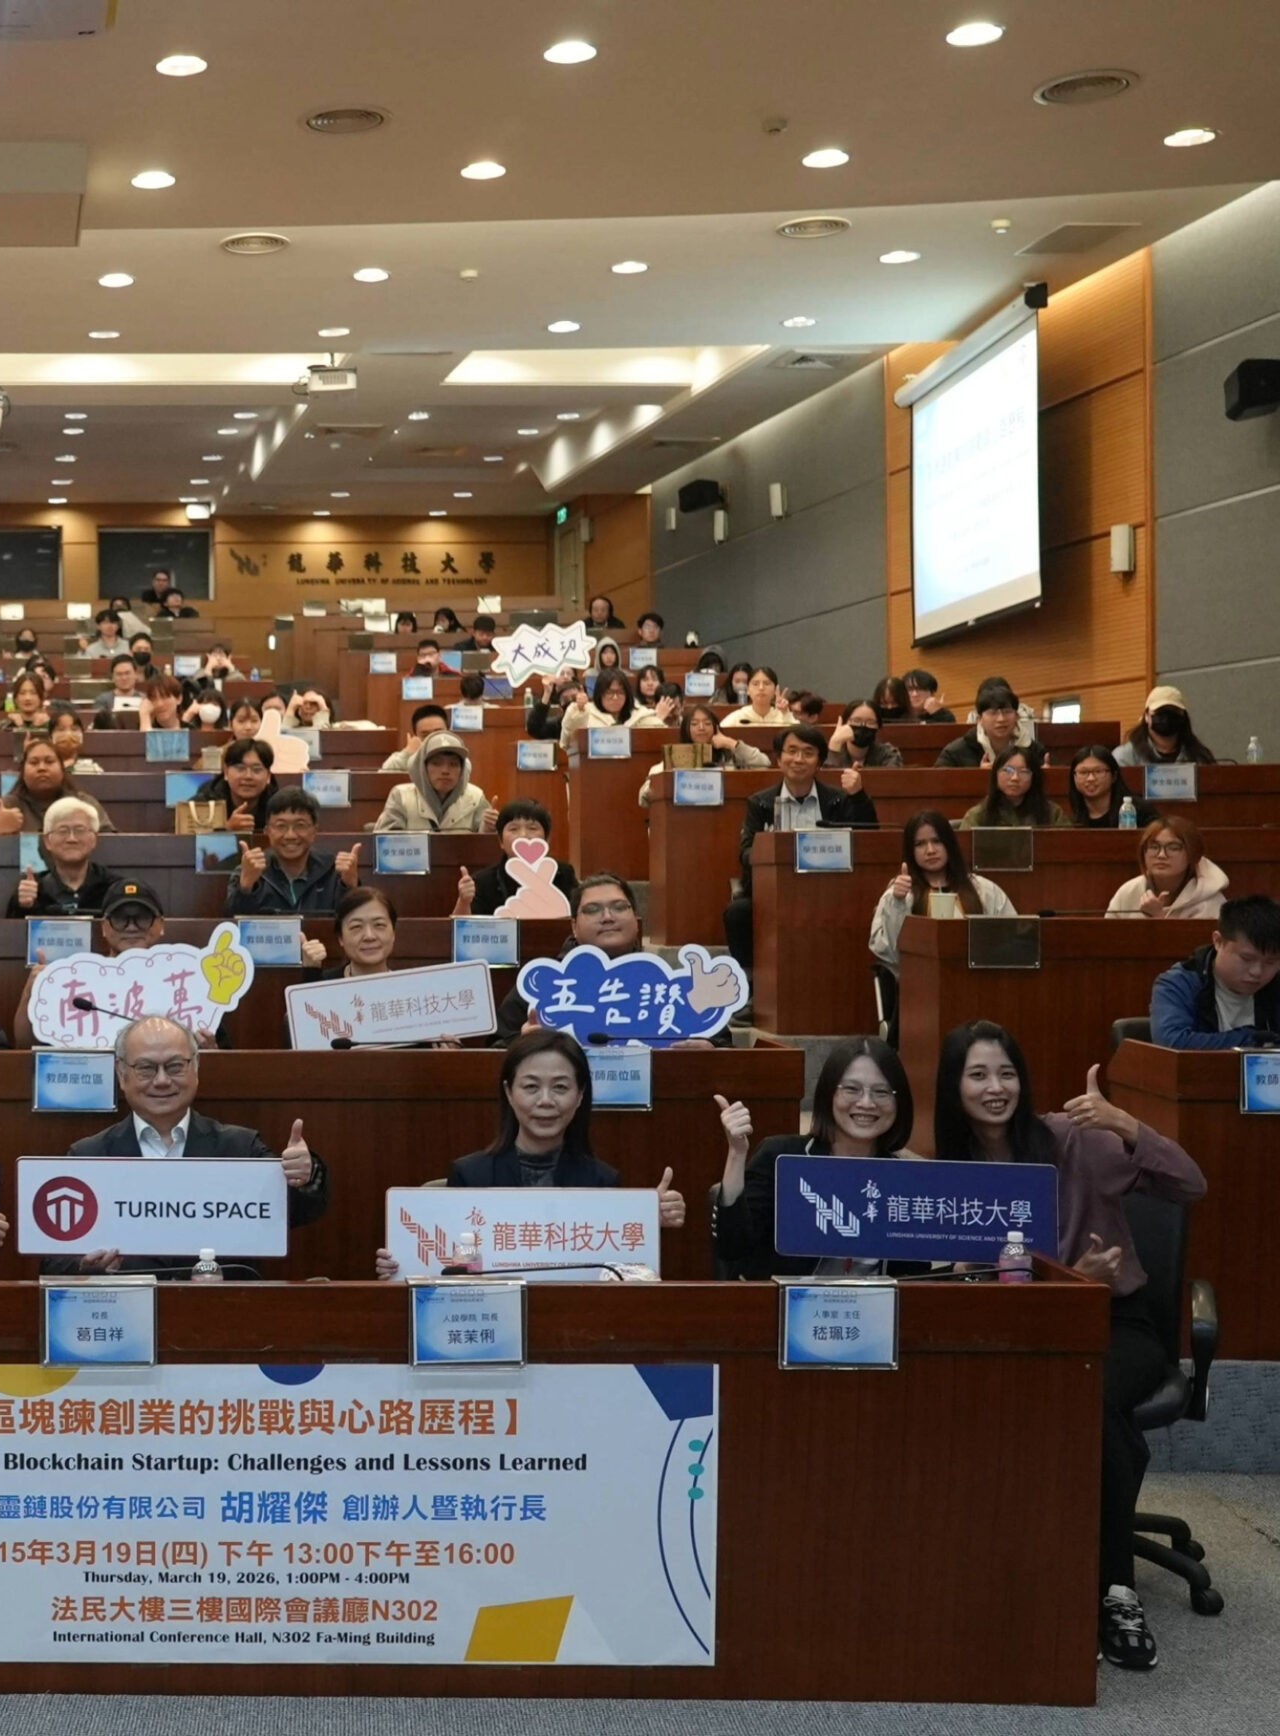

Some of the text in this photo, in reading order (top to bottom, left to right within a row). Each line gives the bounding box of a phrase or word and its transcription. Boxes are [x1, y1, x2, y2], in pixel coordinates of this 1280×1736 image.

[287, 551, 495, 574] 龍華科技大學
[60, 969, 202, 1037] 南波萬
[370, 989, 476, 1023] 龍華科技大學
[545, 977, 686, 1035] 五告讚
[114, 1201, 271, 1219] TURING SPACE
[886, 1194, 1033, 1228] 龍華科技大學
[492, 1221, 645, 1251] 龍華科技大學
[76, 1327, 124, 1342] 葛自祥
[3, 1453, 123, 1471] Blockchain
[132, 1453, 219, 1474] Startup:
[227, 1453, 347, 1474] Challenges
[355, 1453, 395, 1471] and
[403, 1453, 490, 1471] Lessons
[499, 1453, 587, 1471] Learned
[220, 1491, 328, 1524] 胡耀傑
[342, 1494, 547, 1521] 創辦人暨執行長
[217, 1540, 273, 1567] 下午
[283, 1540, 515, 1567] 13:00下午至16:00
[83, 1571, 153, 1585] Thursday,
[158, 1572, 202, 1584] March
[208, 1572, 231, 1585] 19,
[236, 1572, 280, 1585] 2026,
[286, 1572, 340, 1584] 1:00PM
[354, 1572, 410, 1584] 4:00PM
[51, 1596, 438, 1623] 法民大樓三樓國際會議廳N302
[52, 1631, 435, 1646] International Conference Hall, N302 Fa-Ming Building
